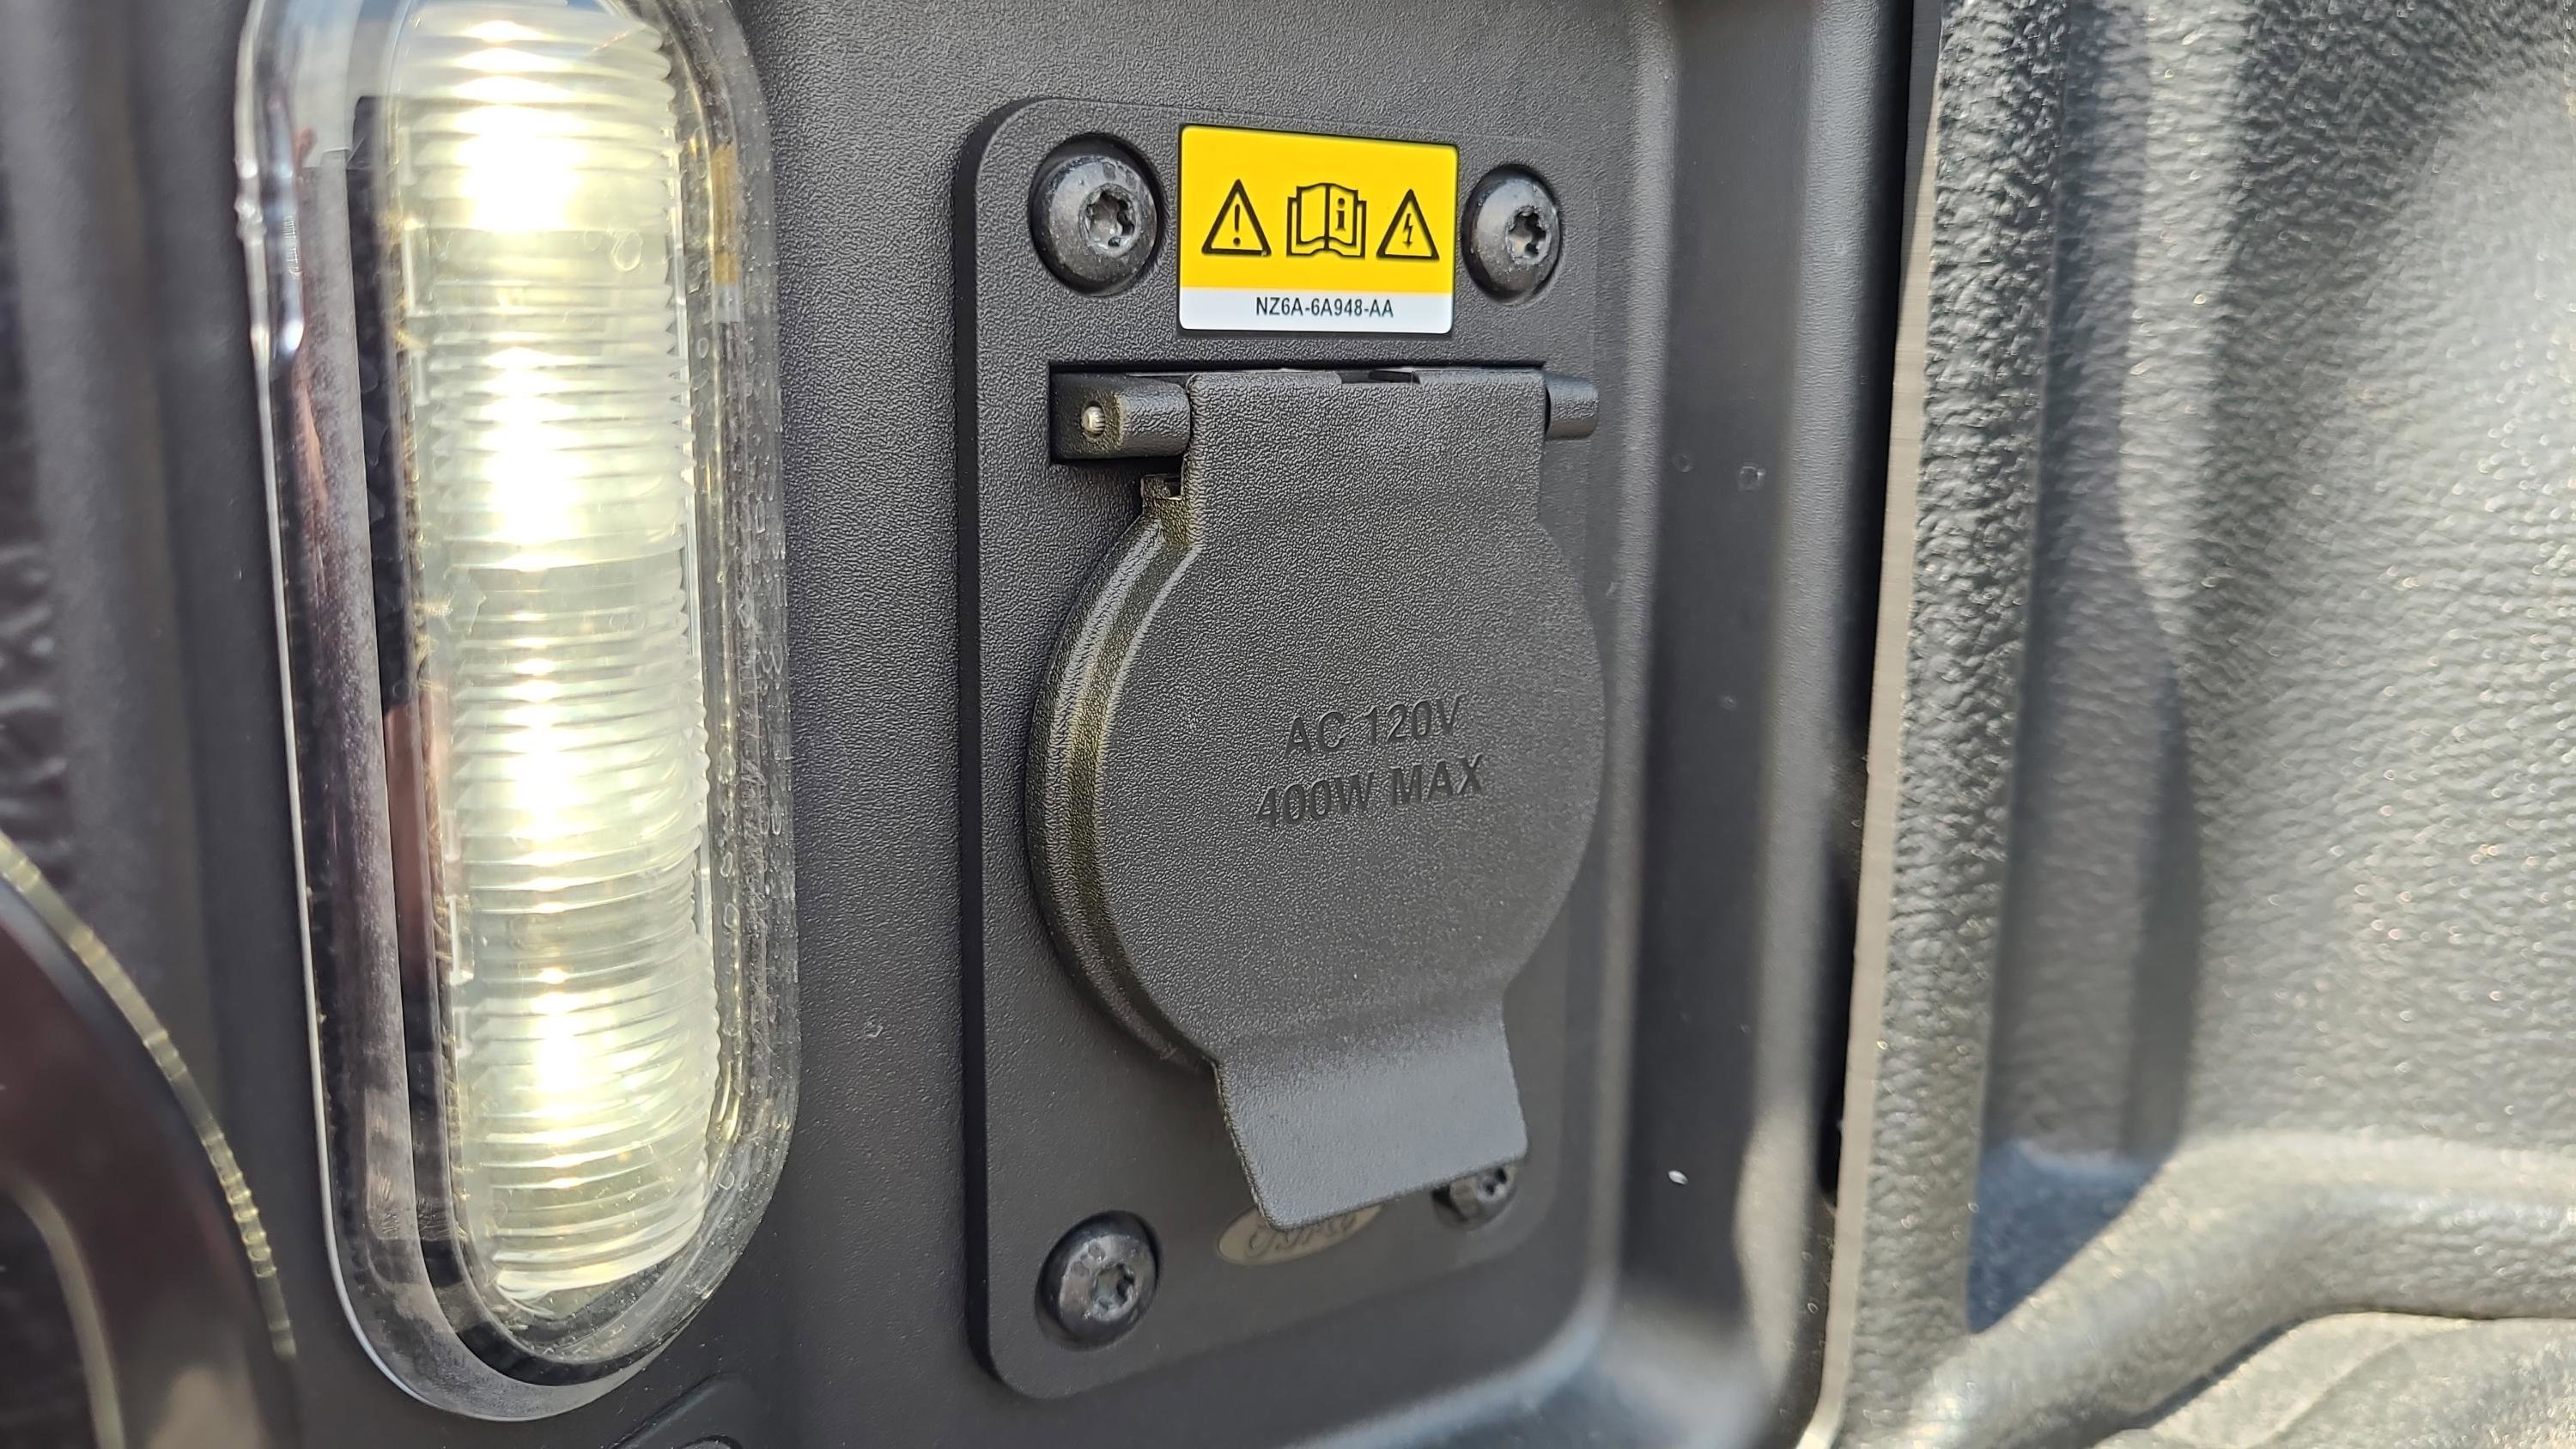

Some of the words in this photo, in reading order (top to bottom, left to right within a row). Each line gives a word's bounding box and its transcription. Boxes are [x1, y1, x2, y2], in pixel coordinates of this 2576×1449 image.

[1255, 295, 1394, 318] NZ6A-6A948-AA
[1285, 711, 1346, 757] AC
[1357, 693, 1465, 747] 120V
[1255, 772, 1375, 826] 400W
[1389, 752, 1483, 807] MAX
